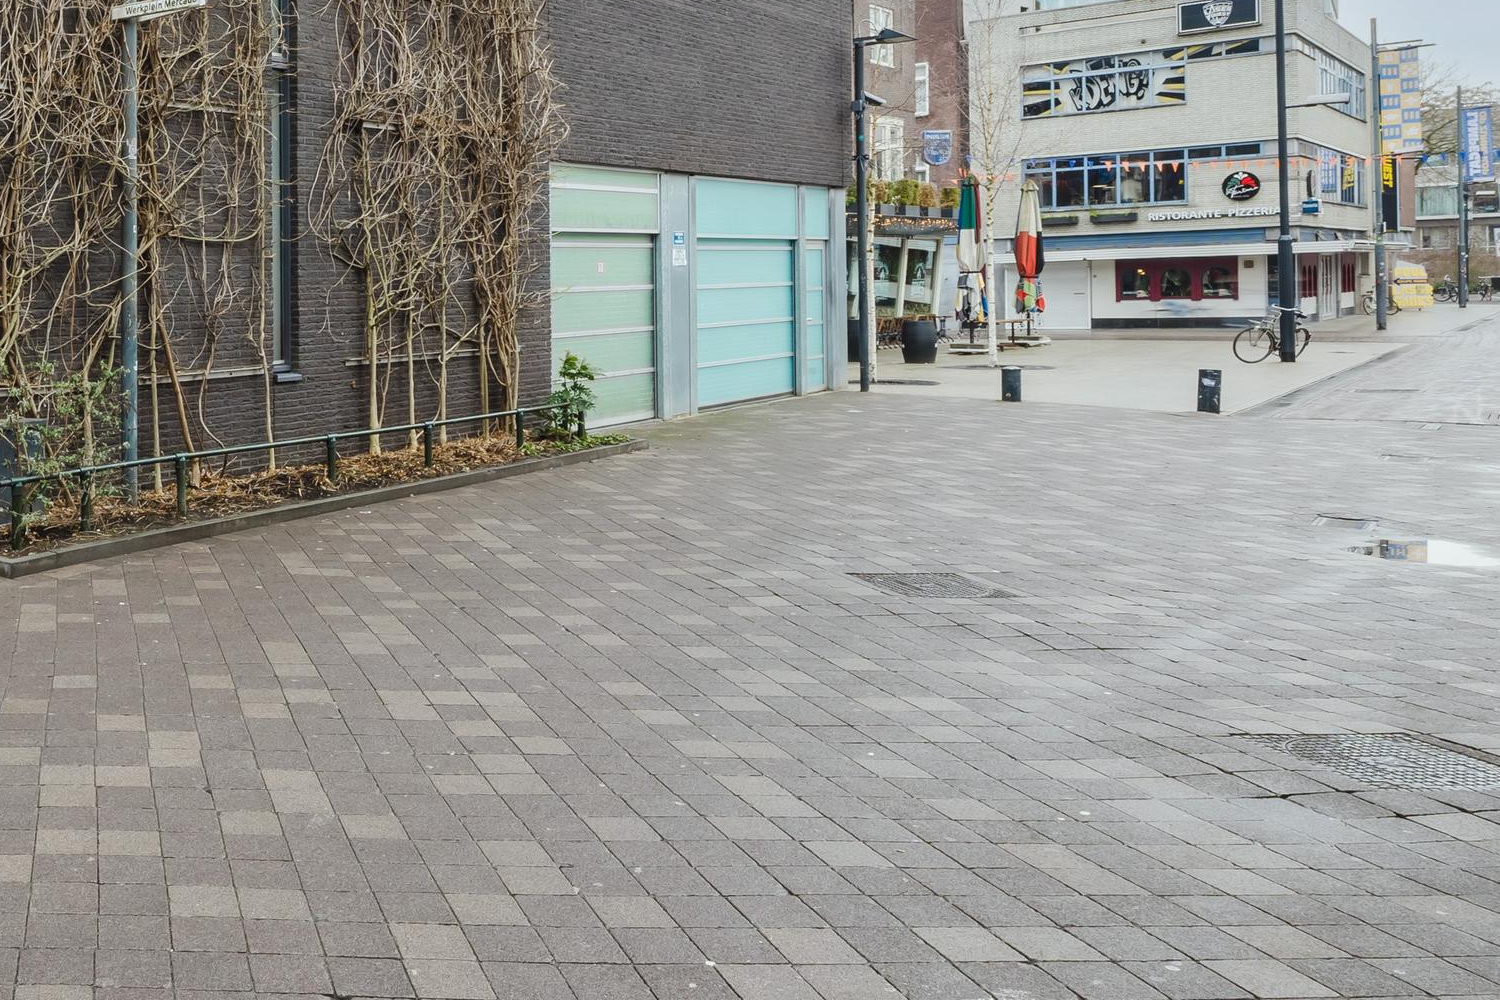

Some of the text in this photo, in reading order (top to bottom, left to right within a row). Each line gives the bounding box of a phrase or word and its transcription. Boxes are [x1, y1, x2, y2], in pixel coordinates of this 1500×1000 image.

[125, 2, 162, 15] Werkplein
[1148, 206, 1281, 221] RISTORANTE PIZZERIA
